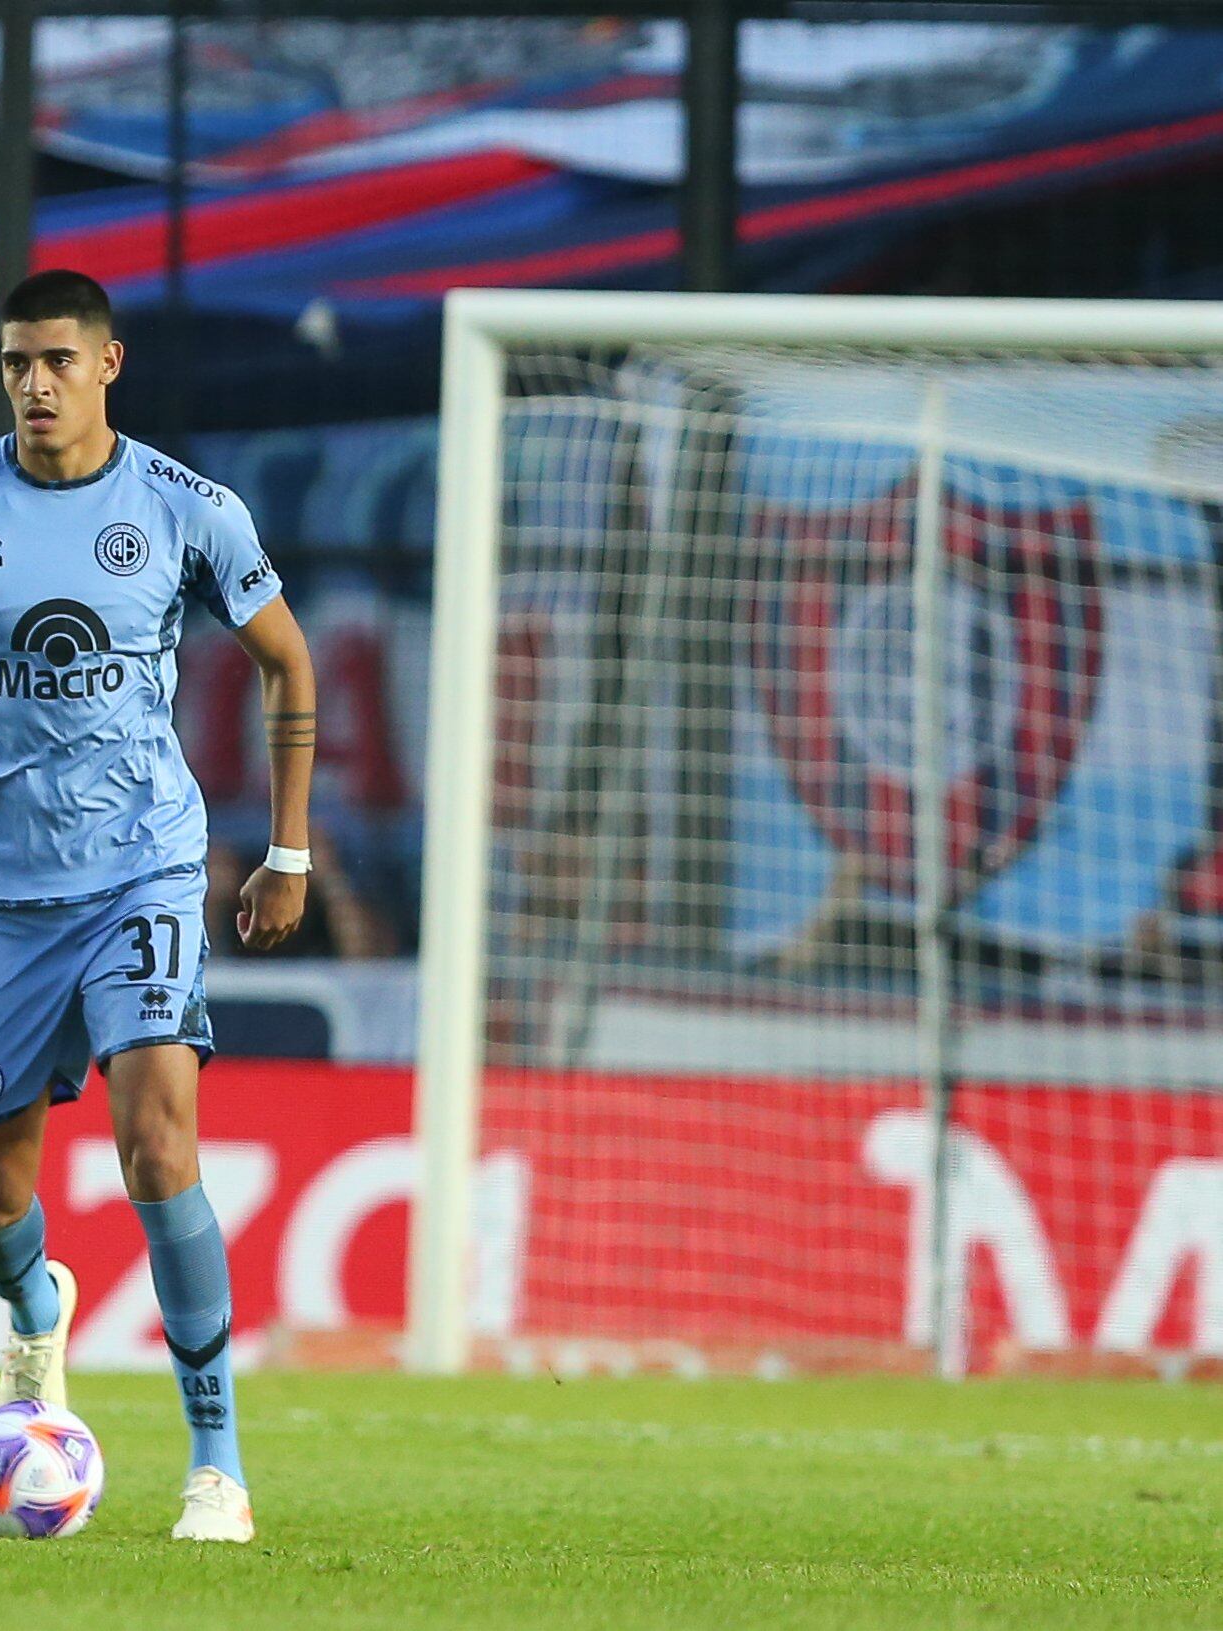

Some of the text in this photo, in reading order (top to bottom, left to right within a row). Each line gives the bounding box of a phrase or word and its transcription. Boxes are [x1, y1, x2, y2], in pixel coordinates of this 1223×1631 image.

[147, 459, 226, 507] SANOS
[121, 914, 179, 981] 37
[139, 1008, 173, 1020] errea
